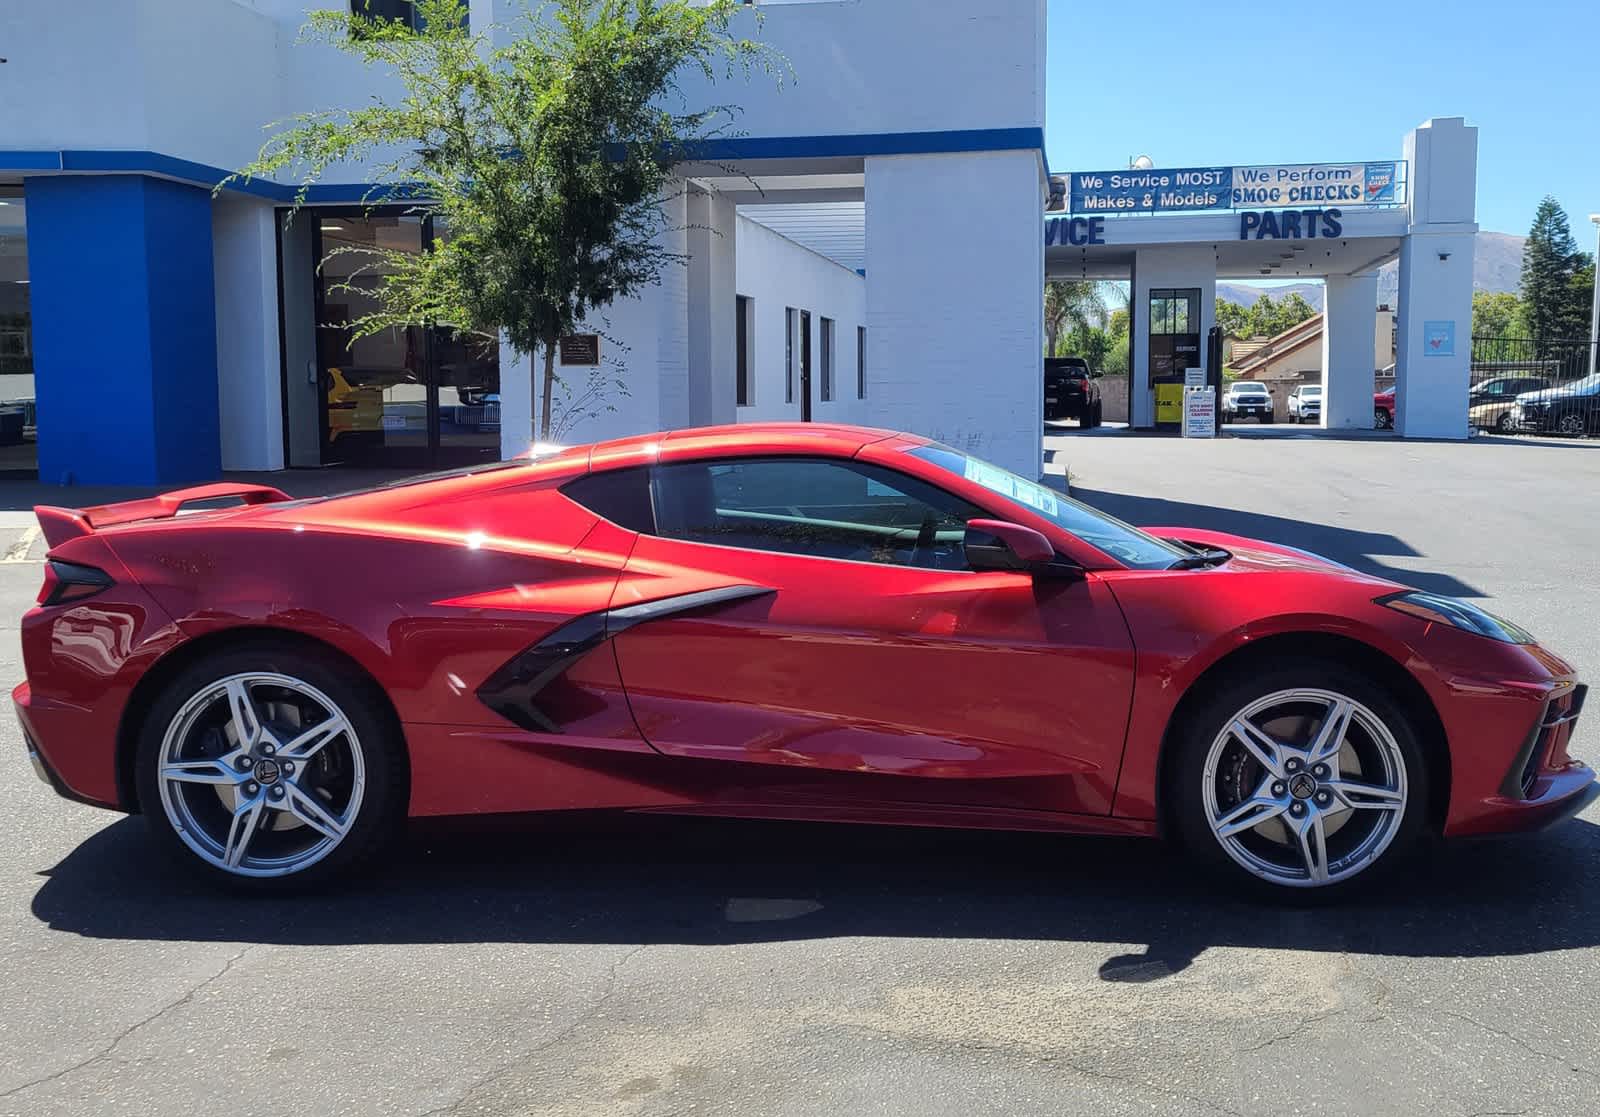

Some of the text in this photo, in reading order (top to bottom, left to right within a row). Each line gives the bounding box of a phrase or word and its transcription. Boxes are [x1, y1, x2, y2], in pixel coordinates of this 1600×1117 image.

[1080, 171, 1223, 189] We Service MOST
[1242, 167, 1352, 183] We Perform
[1084, 192, 1217, 209] Makes & Models
[1233, 184, 1361, 203] SMOG CHECKS
[1241, 208, 1342, 240] PARTS
